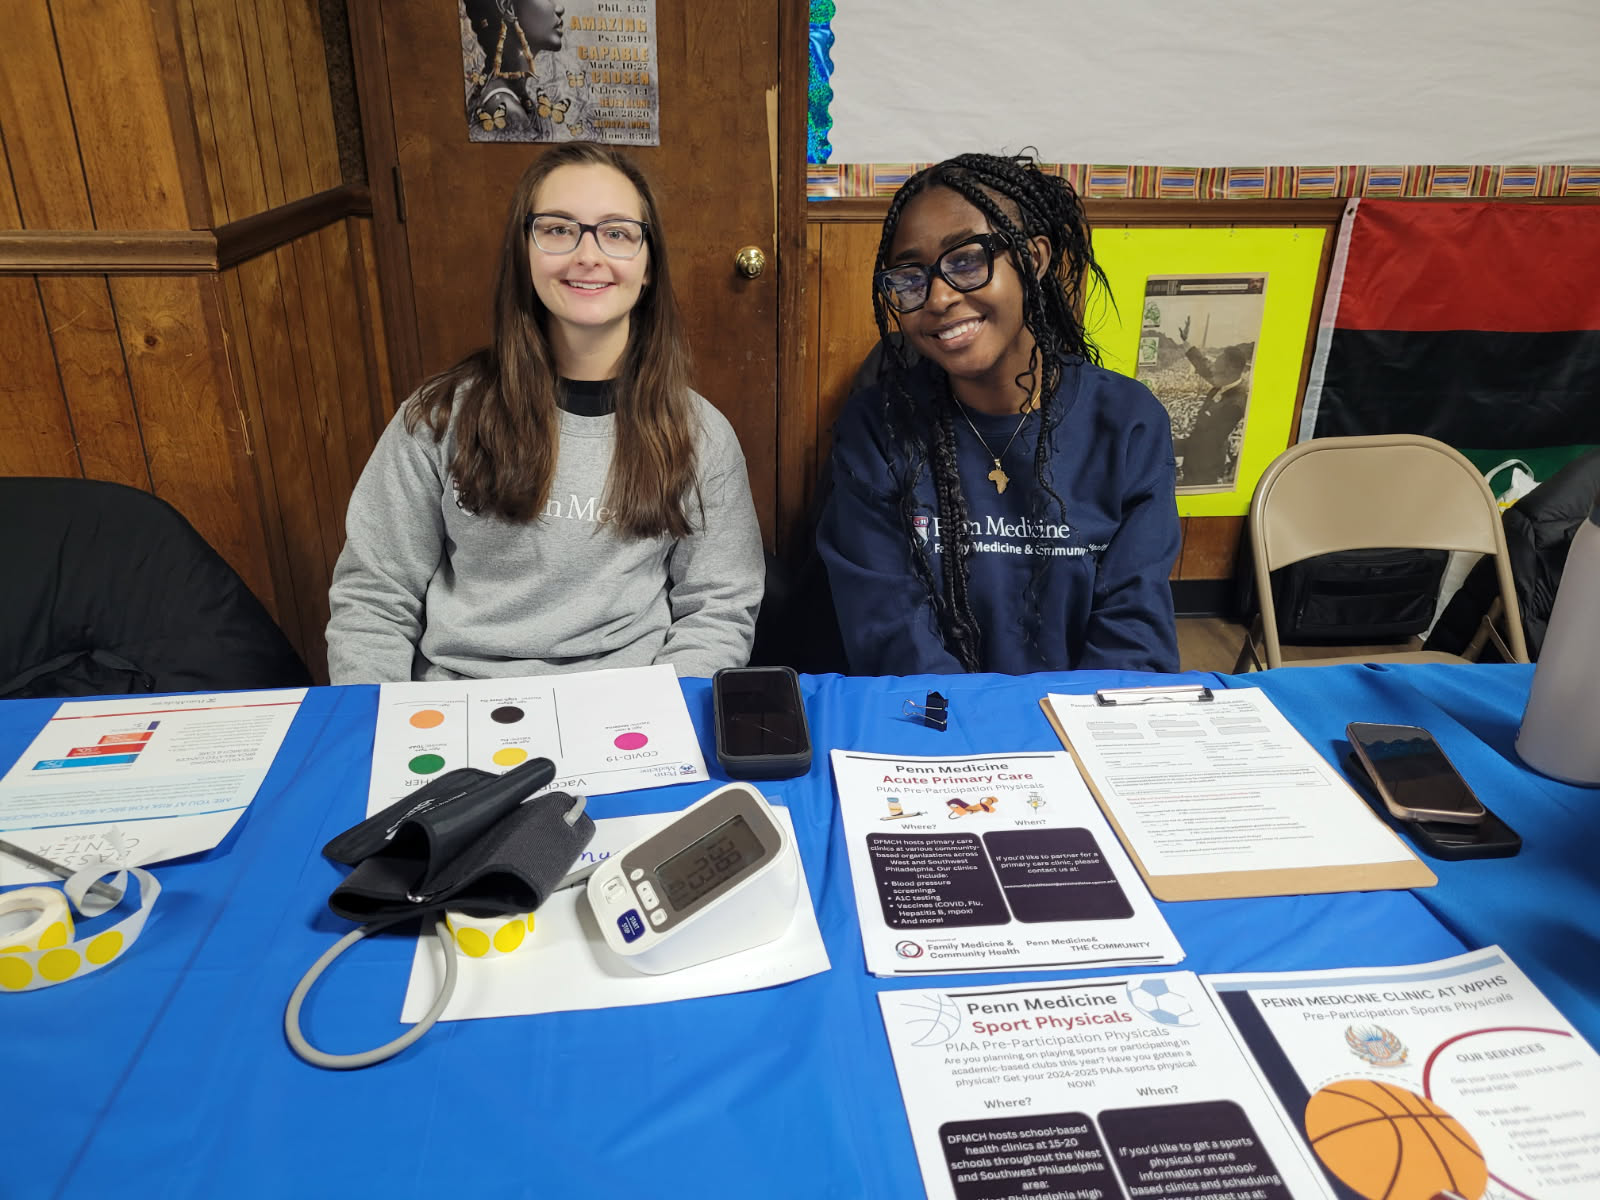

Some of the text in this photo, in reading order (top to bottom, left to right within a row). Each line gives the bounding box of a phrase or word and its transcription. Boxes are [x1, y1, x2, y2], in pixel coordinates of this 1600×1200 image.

[570, 15, 648, 33] AMAZING
[577, 45, 649, 62] CAPABLE
[591, 71, 650, 86] CHOSEN
[932, 516, 1070, 538] Pn Medicine
[934, 542, 1033, 556] Fay Medicine &
[606, 750, 658, 762] COVID-19
[896, 762, 1008, 774] Penn Medicine
[535, 778, 587, 792] Vaccin
[877, 783, 1044, 794] PIAA Pre-Participation Physicals
[883, 776, 928, 785] Acute
[932, 775, 993, 785] Primary
[628, 916, 640, 930] START
[898, 910, 937, 918] Hepatitis
[622, 922, 630, 934] STOP
[928, 943, 958, 952] Family
[962, 940, 1004, 950] Medicine
[930, 948, 1020, 960] Community Health
[1092, 941, 1150, 950] COMMUNITY
[1260, 976, 1508, 1008] PENN MEDICINE CLINIC AT WPHS
[967, 994, 1118, 1014] Penn Medicine
[1302, 992, 1514, 1022] Pre-Participation Sports Physicals
[972, 1010, 1132, 1036] Sport Physicals
[945, 1026, 1170, 1052] PIAA Pre-Participation Physicals
[961, 1056, 981, 1067] you
[982, 1052, 1025, 1065] planning
[1026, 1052, 1038, 1060] on
[1040, 1048, 1075, 1061] playing
[1076, 1046, 1107, 1058] sports
[1120, 1039, 1180, 1054] participating
[1180, 1038, 1190, 1046] in
[1456, 1042, 1546, 1062] OUR SERVICES
[952, 1060, 1030, 1076] academic-based
[1032, 1058, 1058, 1068] clubs
[1059, 1057, 1080, 1066] this
[1080, 1054, 1106, 1067] year?
[1106, 1053, 1130, 1063] Have
[1131, 1053, 1152, 1064] you
[1152, 1050, 1183, 1062] gotten
[956, 1059, 1197, 1088] physical? Get your 2024-2025 PIAA sports physical
[1067, 1080, 1096, 1088] NOW!
[1136, 1085, 1179, 1097] When?
[984, 1096, 1032, 1108] Where?
[946, 1124, 1088, 1144] DFMCH hosts school-based
[965, 1138, 1078, 1156] health clinics at 15-20
[1119, 1137, 1253, 1158] If you'd like to get a sports
[951, 1148, 1102, 1170] schools throughout the West
[1149, 1155, 1193, 1170] physical
[1207, 1152, 1236, 1162] more
[957, 1161, 1104, 1183] and Southwest Philadelphia
[1138, 1161, 1257, 1182] information on school-
[1022, 1180, 1050, 1190] area:
[1130, 1183, 1166, 1197] based
[1164, 1180, 1199, 1193] clinics
[1200, 1178, 1220, 1190] and
[1222, 1174, 1282, 1189] scheduling
